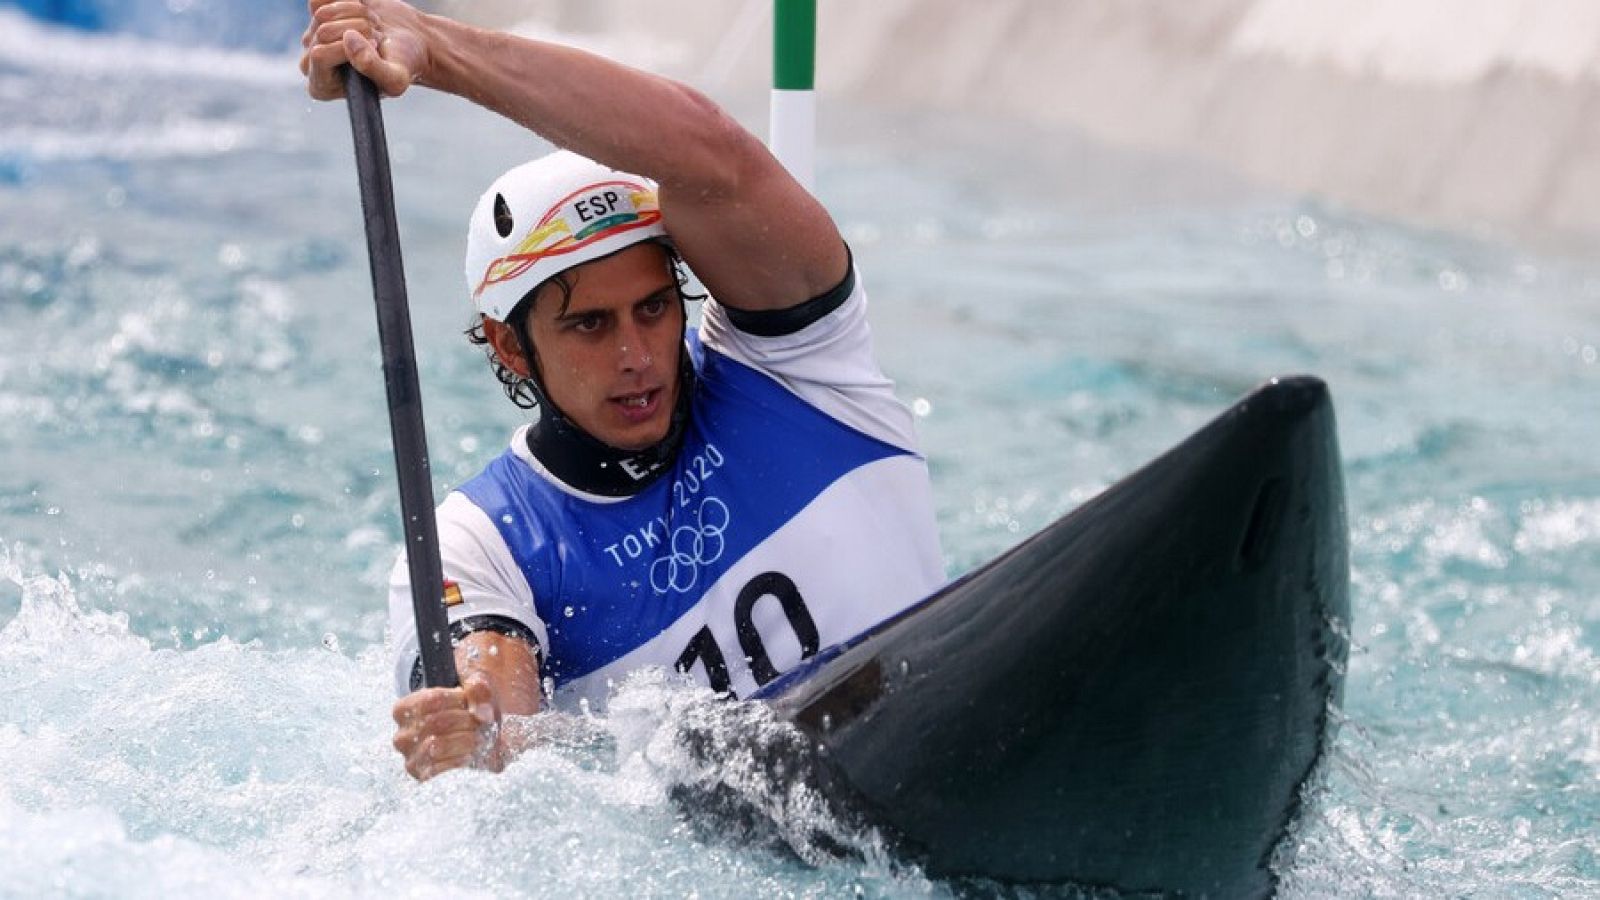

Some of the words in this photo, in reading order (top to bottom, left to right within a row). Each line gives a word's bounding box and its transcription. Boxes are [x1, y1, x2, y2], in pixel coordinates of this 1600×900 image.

[574, 191, 619, 223] ESP
[603, 507, 675, 567] TOKY
[673, 443, 725, 508] 2020
[673, 570, 820, 701] 10
